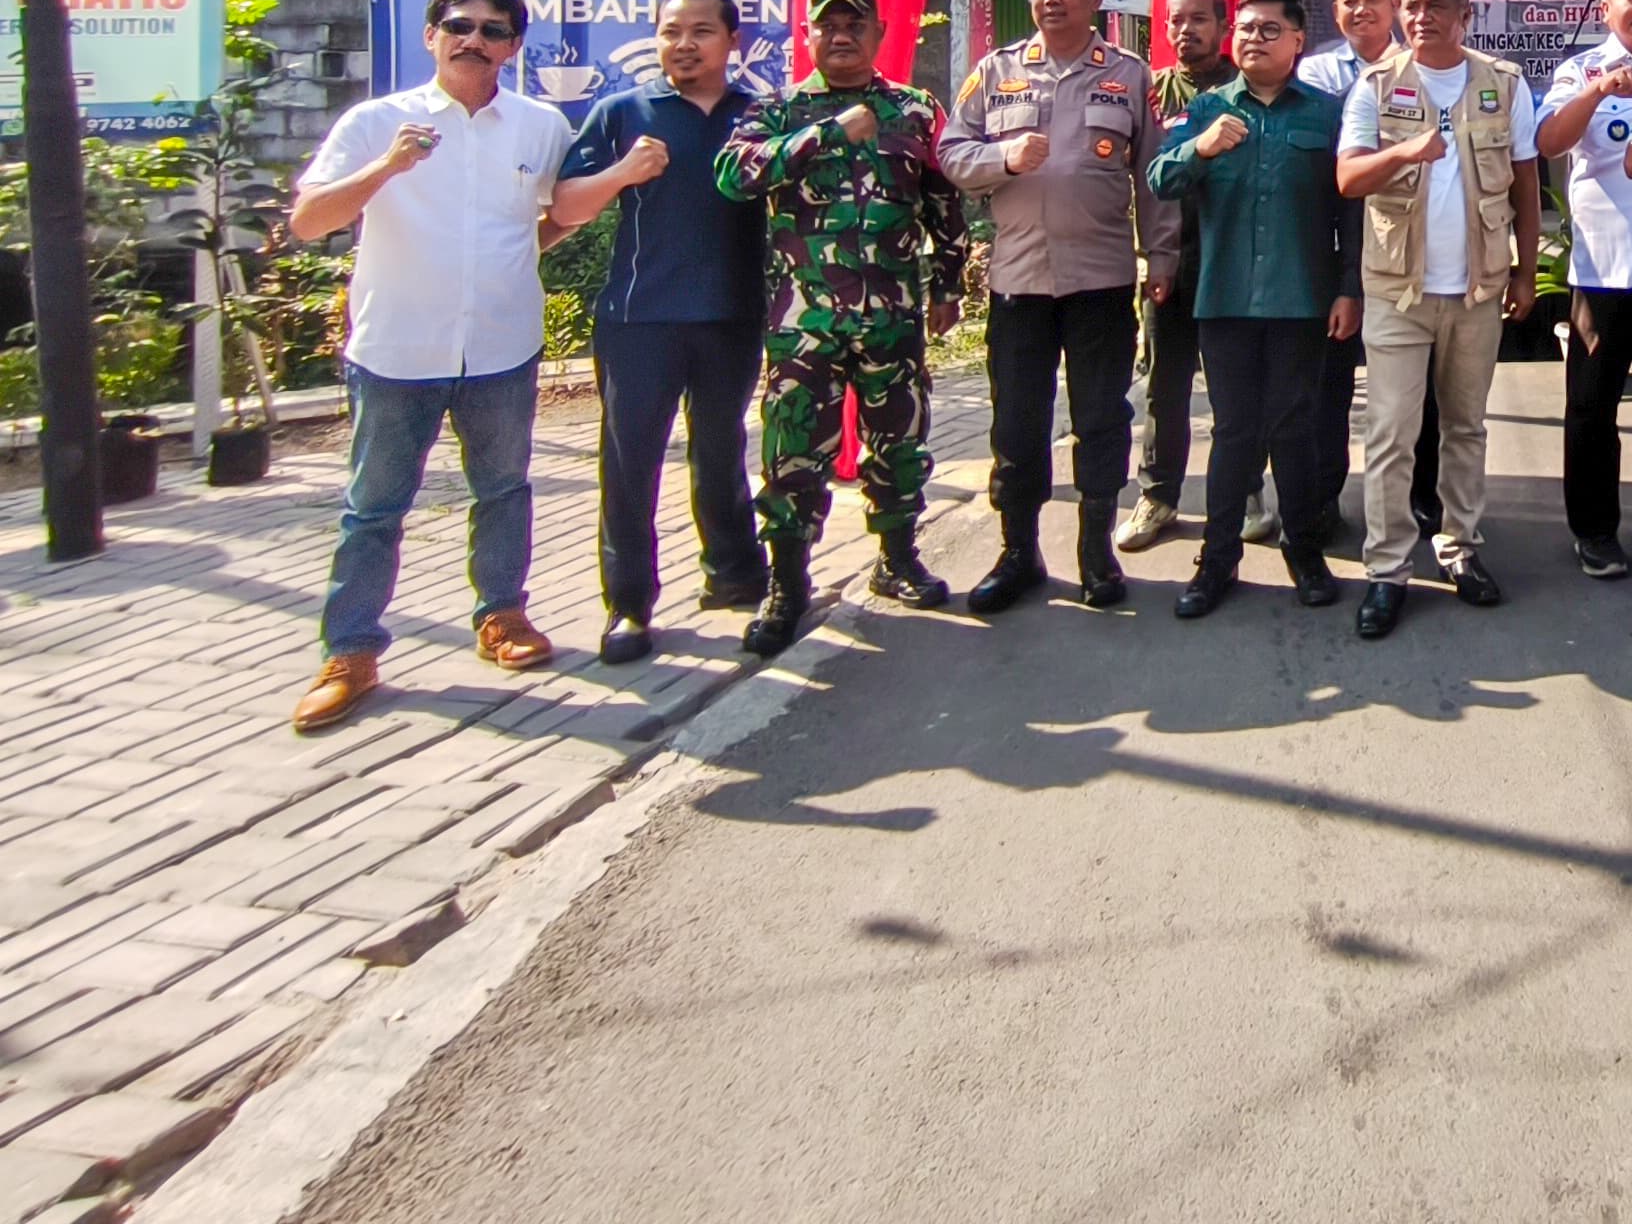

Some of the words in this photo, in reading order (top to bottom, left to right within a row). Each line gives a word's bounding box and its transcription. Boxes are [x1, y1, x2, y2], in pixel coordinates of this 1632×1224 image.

[1525, 6, 1558, 23] dan
[1564, 7, 1604, 22] HUT
[70, 17, 176, 36] SOLUTION
[1472, 34, 1534, 50] TINGKAT
[1536, 34, 1565, 50] KEC
[1527, 59, 1561, 76] TAH
[990, 92, 1033, 107] TABAH
[1090, 92, 1129, 107] POLRI
